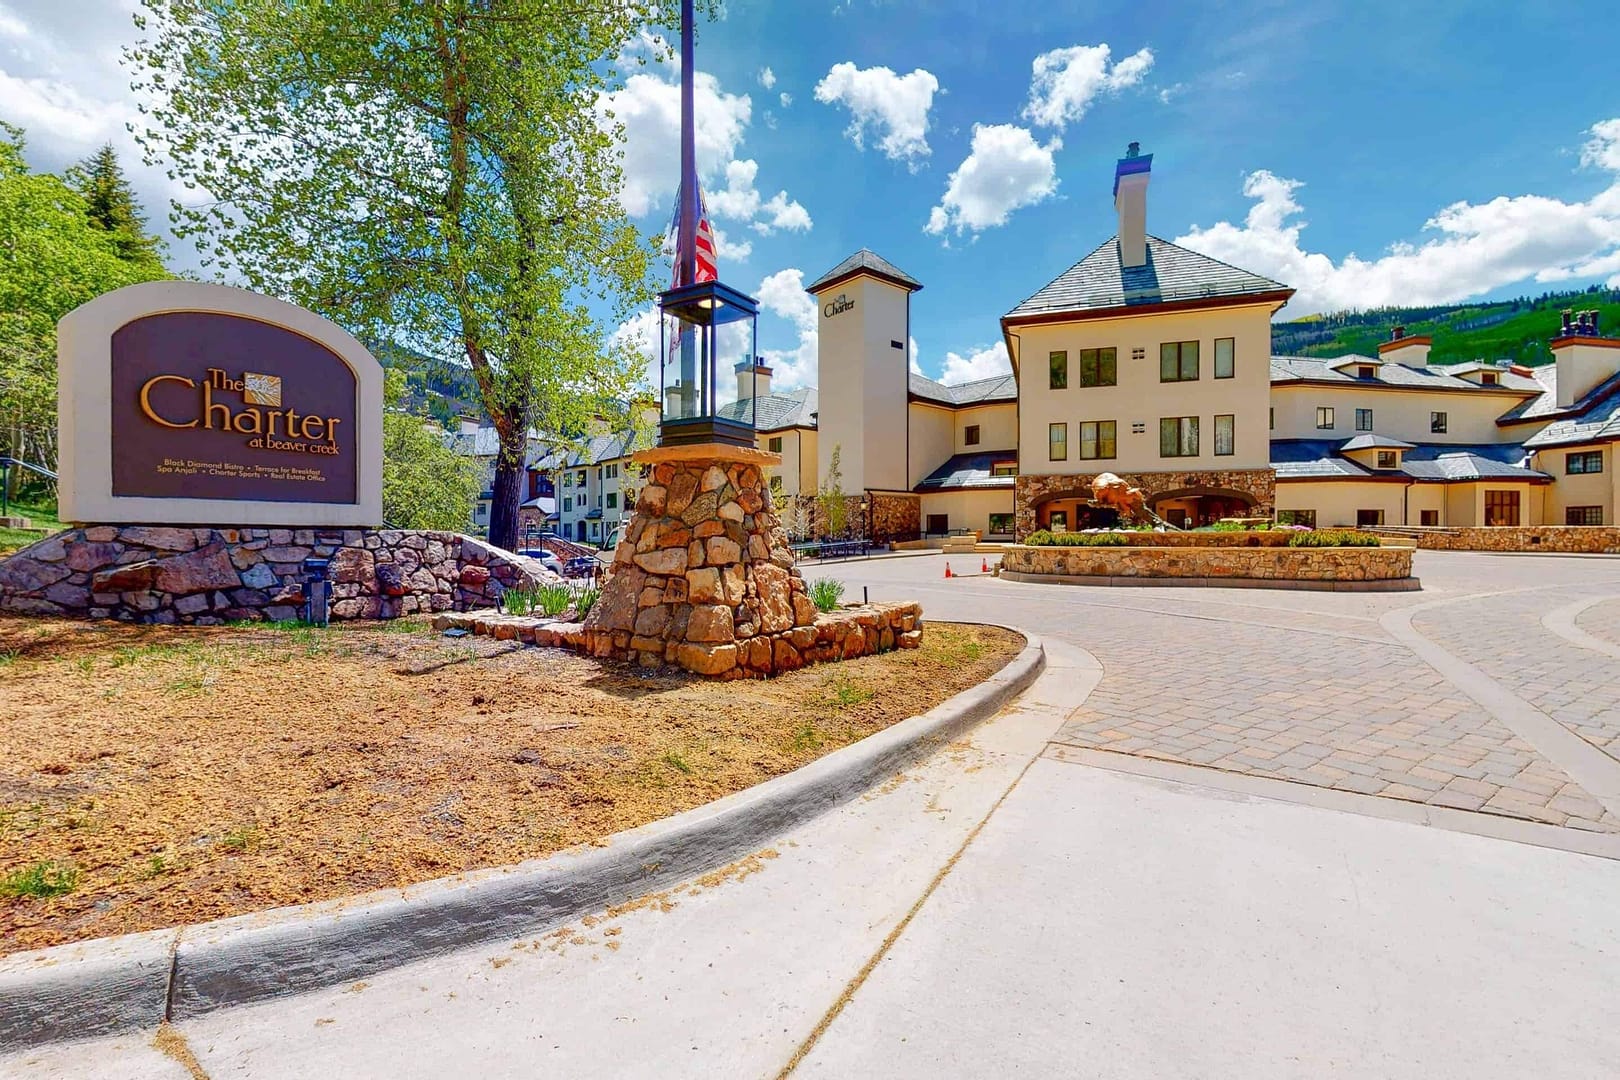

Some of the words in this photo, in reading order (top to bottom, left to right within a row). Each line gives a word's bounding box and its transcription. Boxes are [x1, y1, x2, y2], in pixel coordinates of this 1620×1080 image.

[207, 367, 245, 392] The
[139, 375, 341, 441] Charter
[249, 438, 264, 448] at
[266, 433, 308, 452] beaver
[309, 440, 340, 455] creek
[156, 465, 173, 474] Spa
[209, 468, 237, 476] Charter
[238, 470, 260, 479] Sports
[306, 474, 326, 482] Office
[164, 458, 185, 466] Black
[187, 460, 222, 469] Diamond
[255, 464, 279, 473] Terrace
